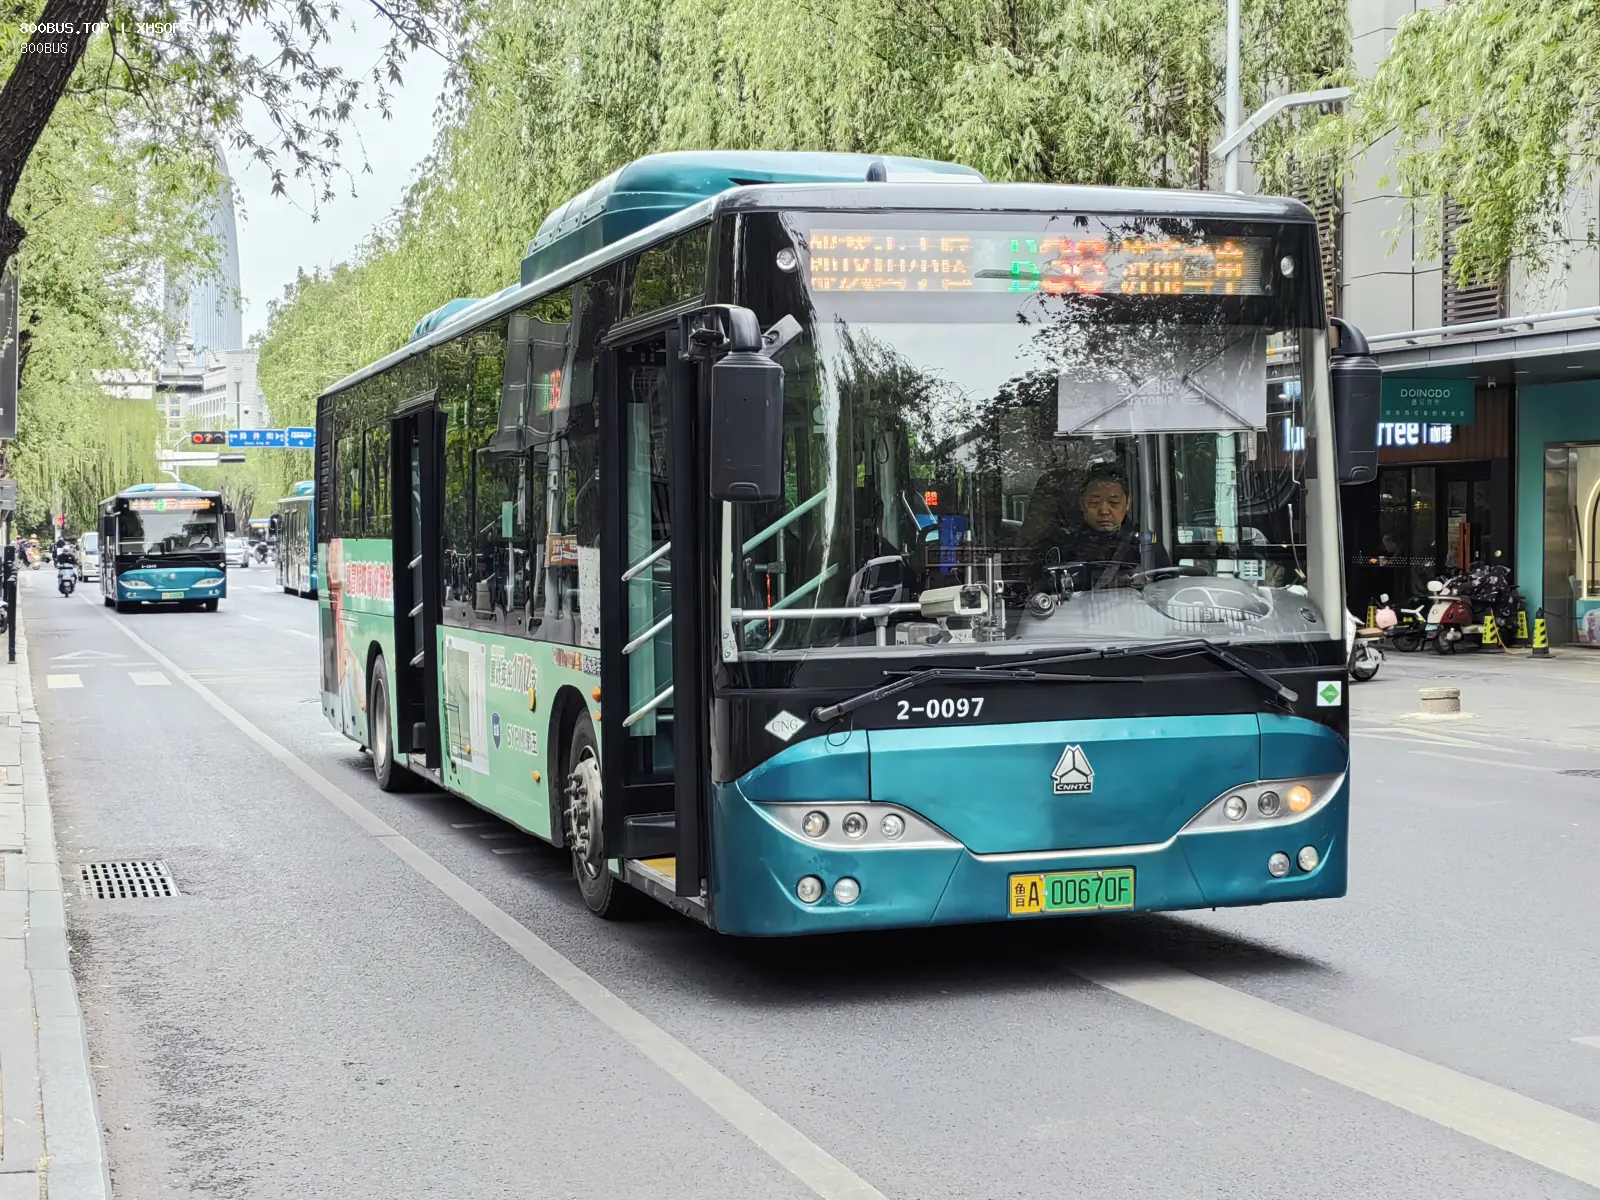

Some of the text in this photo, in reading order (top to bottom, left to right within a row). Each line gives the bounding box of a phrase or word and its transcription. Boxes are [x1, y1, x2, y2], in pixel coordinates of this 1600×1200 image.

[1400, 388, 1451, 398] DOINGDO
[896, 697, 985, 720] 2-0097
[771, 718, 799, 732] CNG
[1056, 783, 1091, 791] CNHTC
[1051, 876, 1130, 906] 00670F
